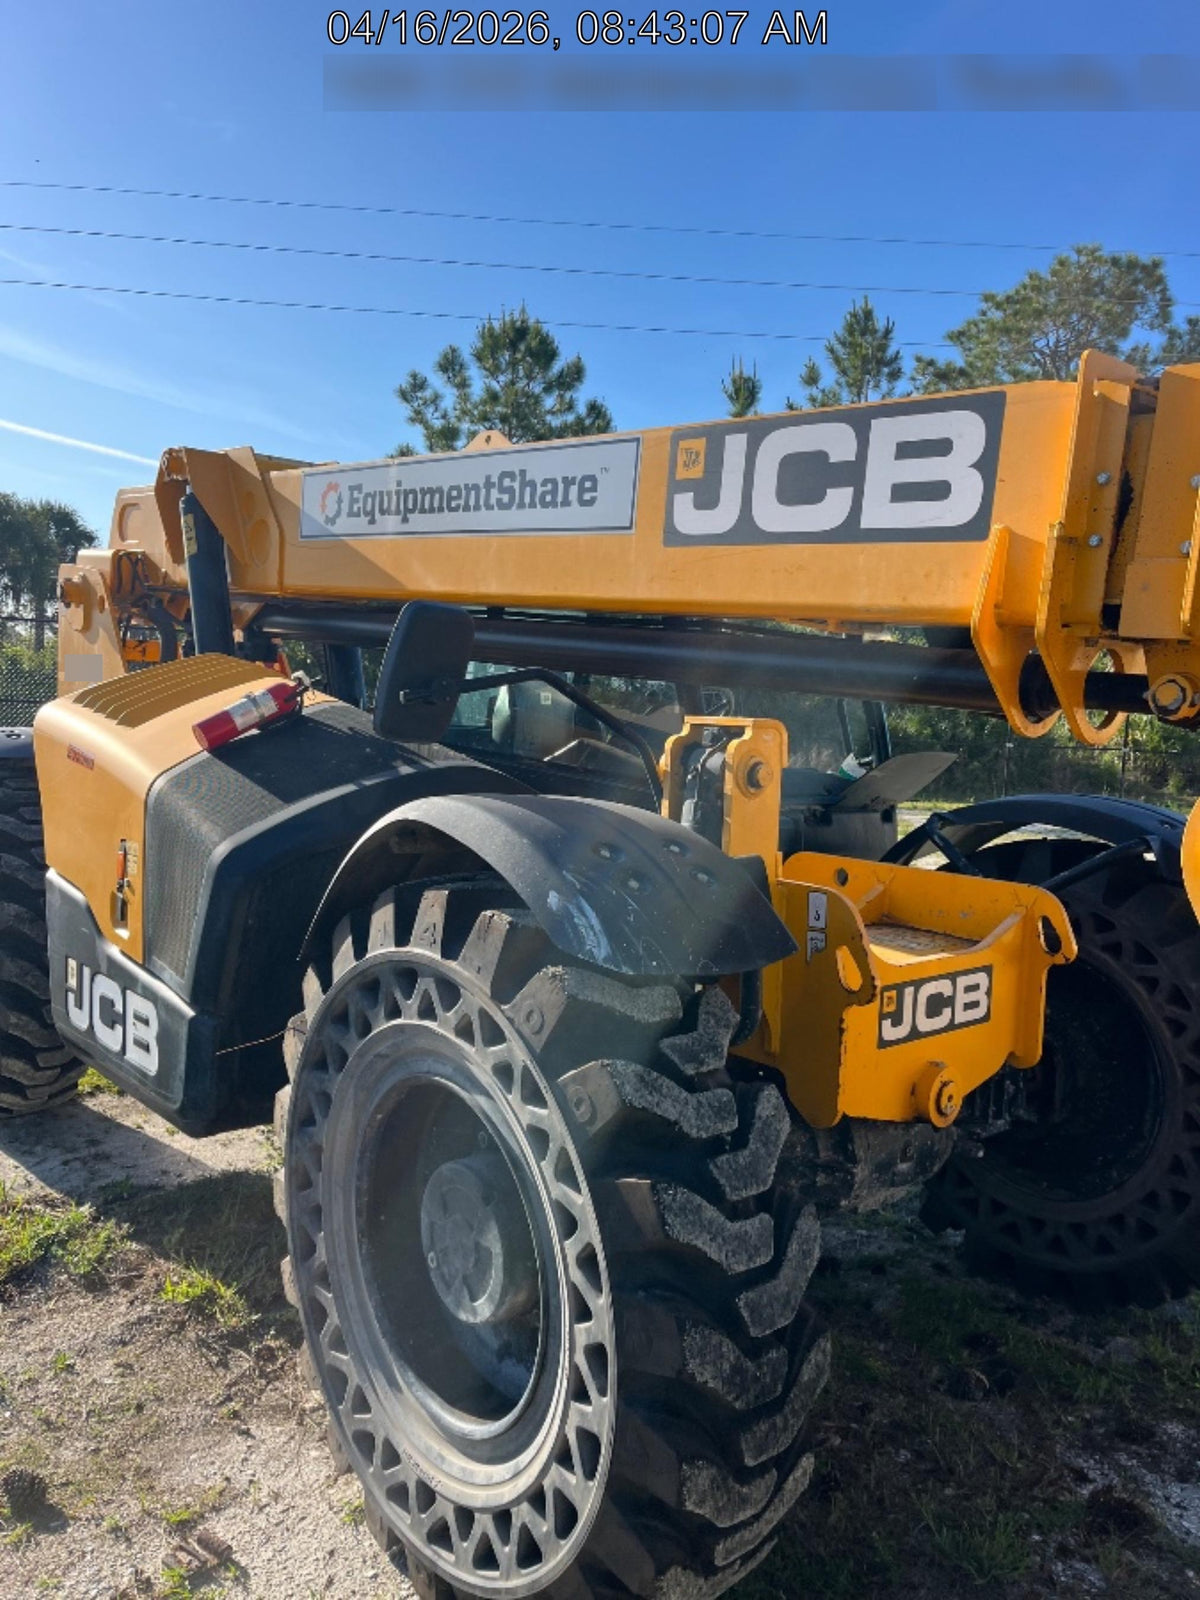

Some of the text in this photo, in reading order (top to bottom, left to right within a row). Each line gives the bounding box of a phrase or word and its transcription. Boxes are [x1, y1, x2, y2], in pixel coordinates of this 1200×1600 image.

[347, 469, 599, 526] EquipmentShare
[673, 410, 987, 535] JCB
[66, 963, 159, 1077] JCB
[881, 971, 990, 1041] JCB
